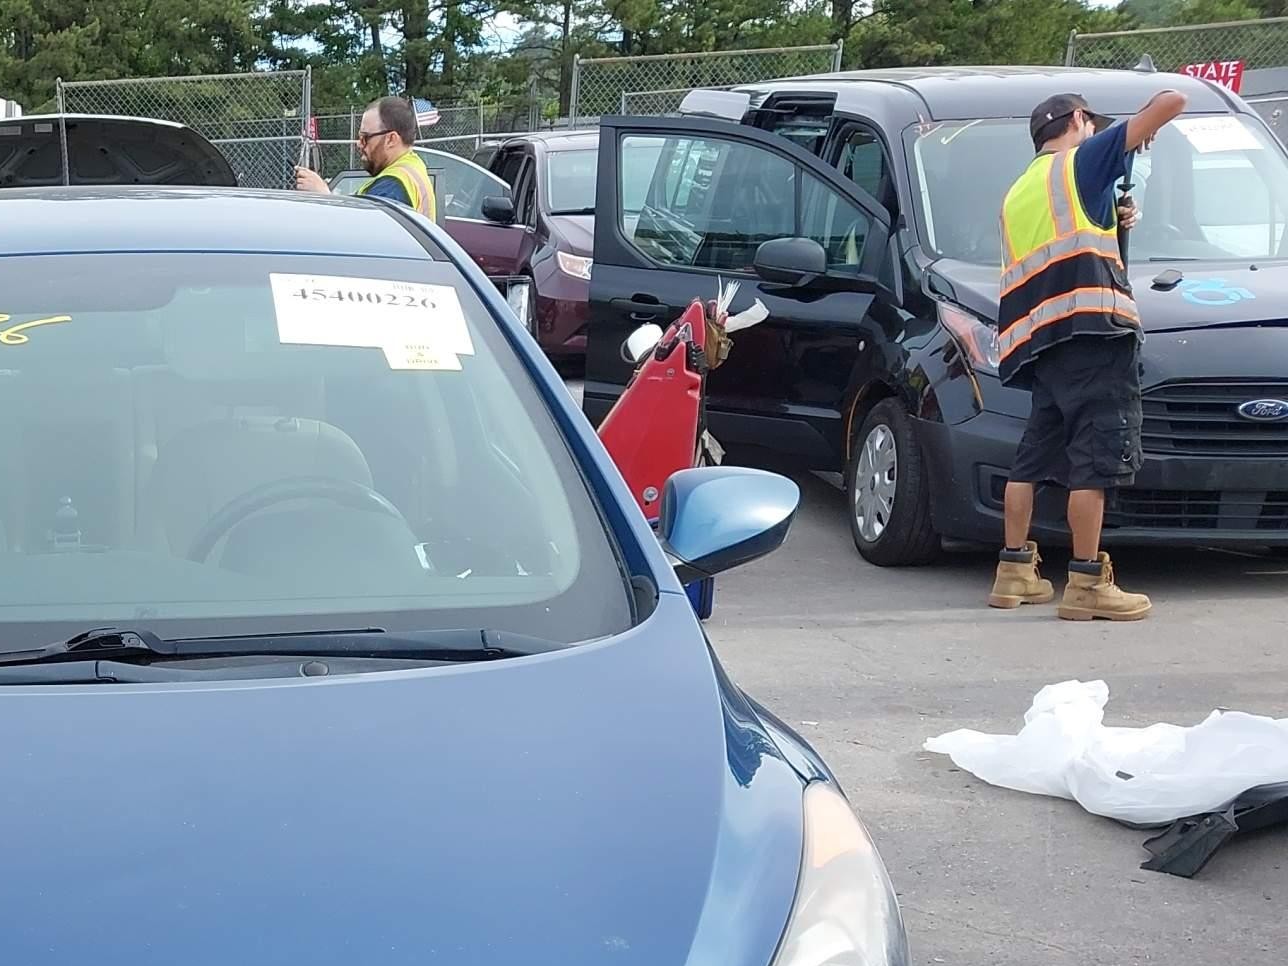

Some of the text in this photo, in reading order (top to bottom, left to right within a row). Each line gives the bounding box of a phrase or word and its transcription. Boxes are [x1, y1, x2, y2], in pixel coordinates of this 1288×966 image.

[1185, 61, 1240, 78] STATE
[292, 287, 438, 310] 45400226
[1252, 402, 1282, 416] Ford
